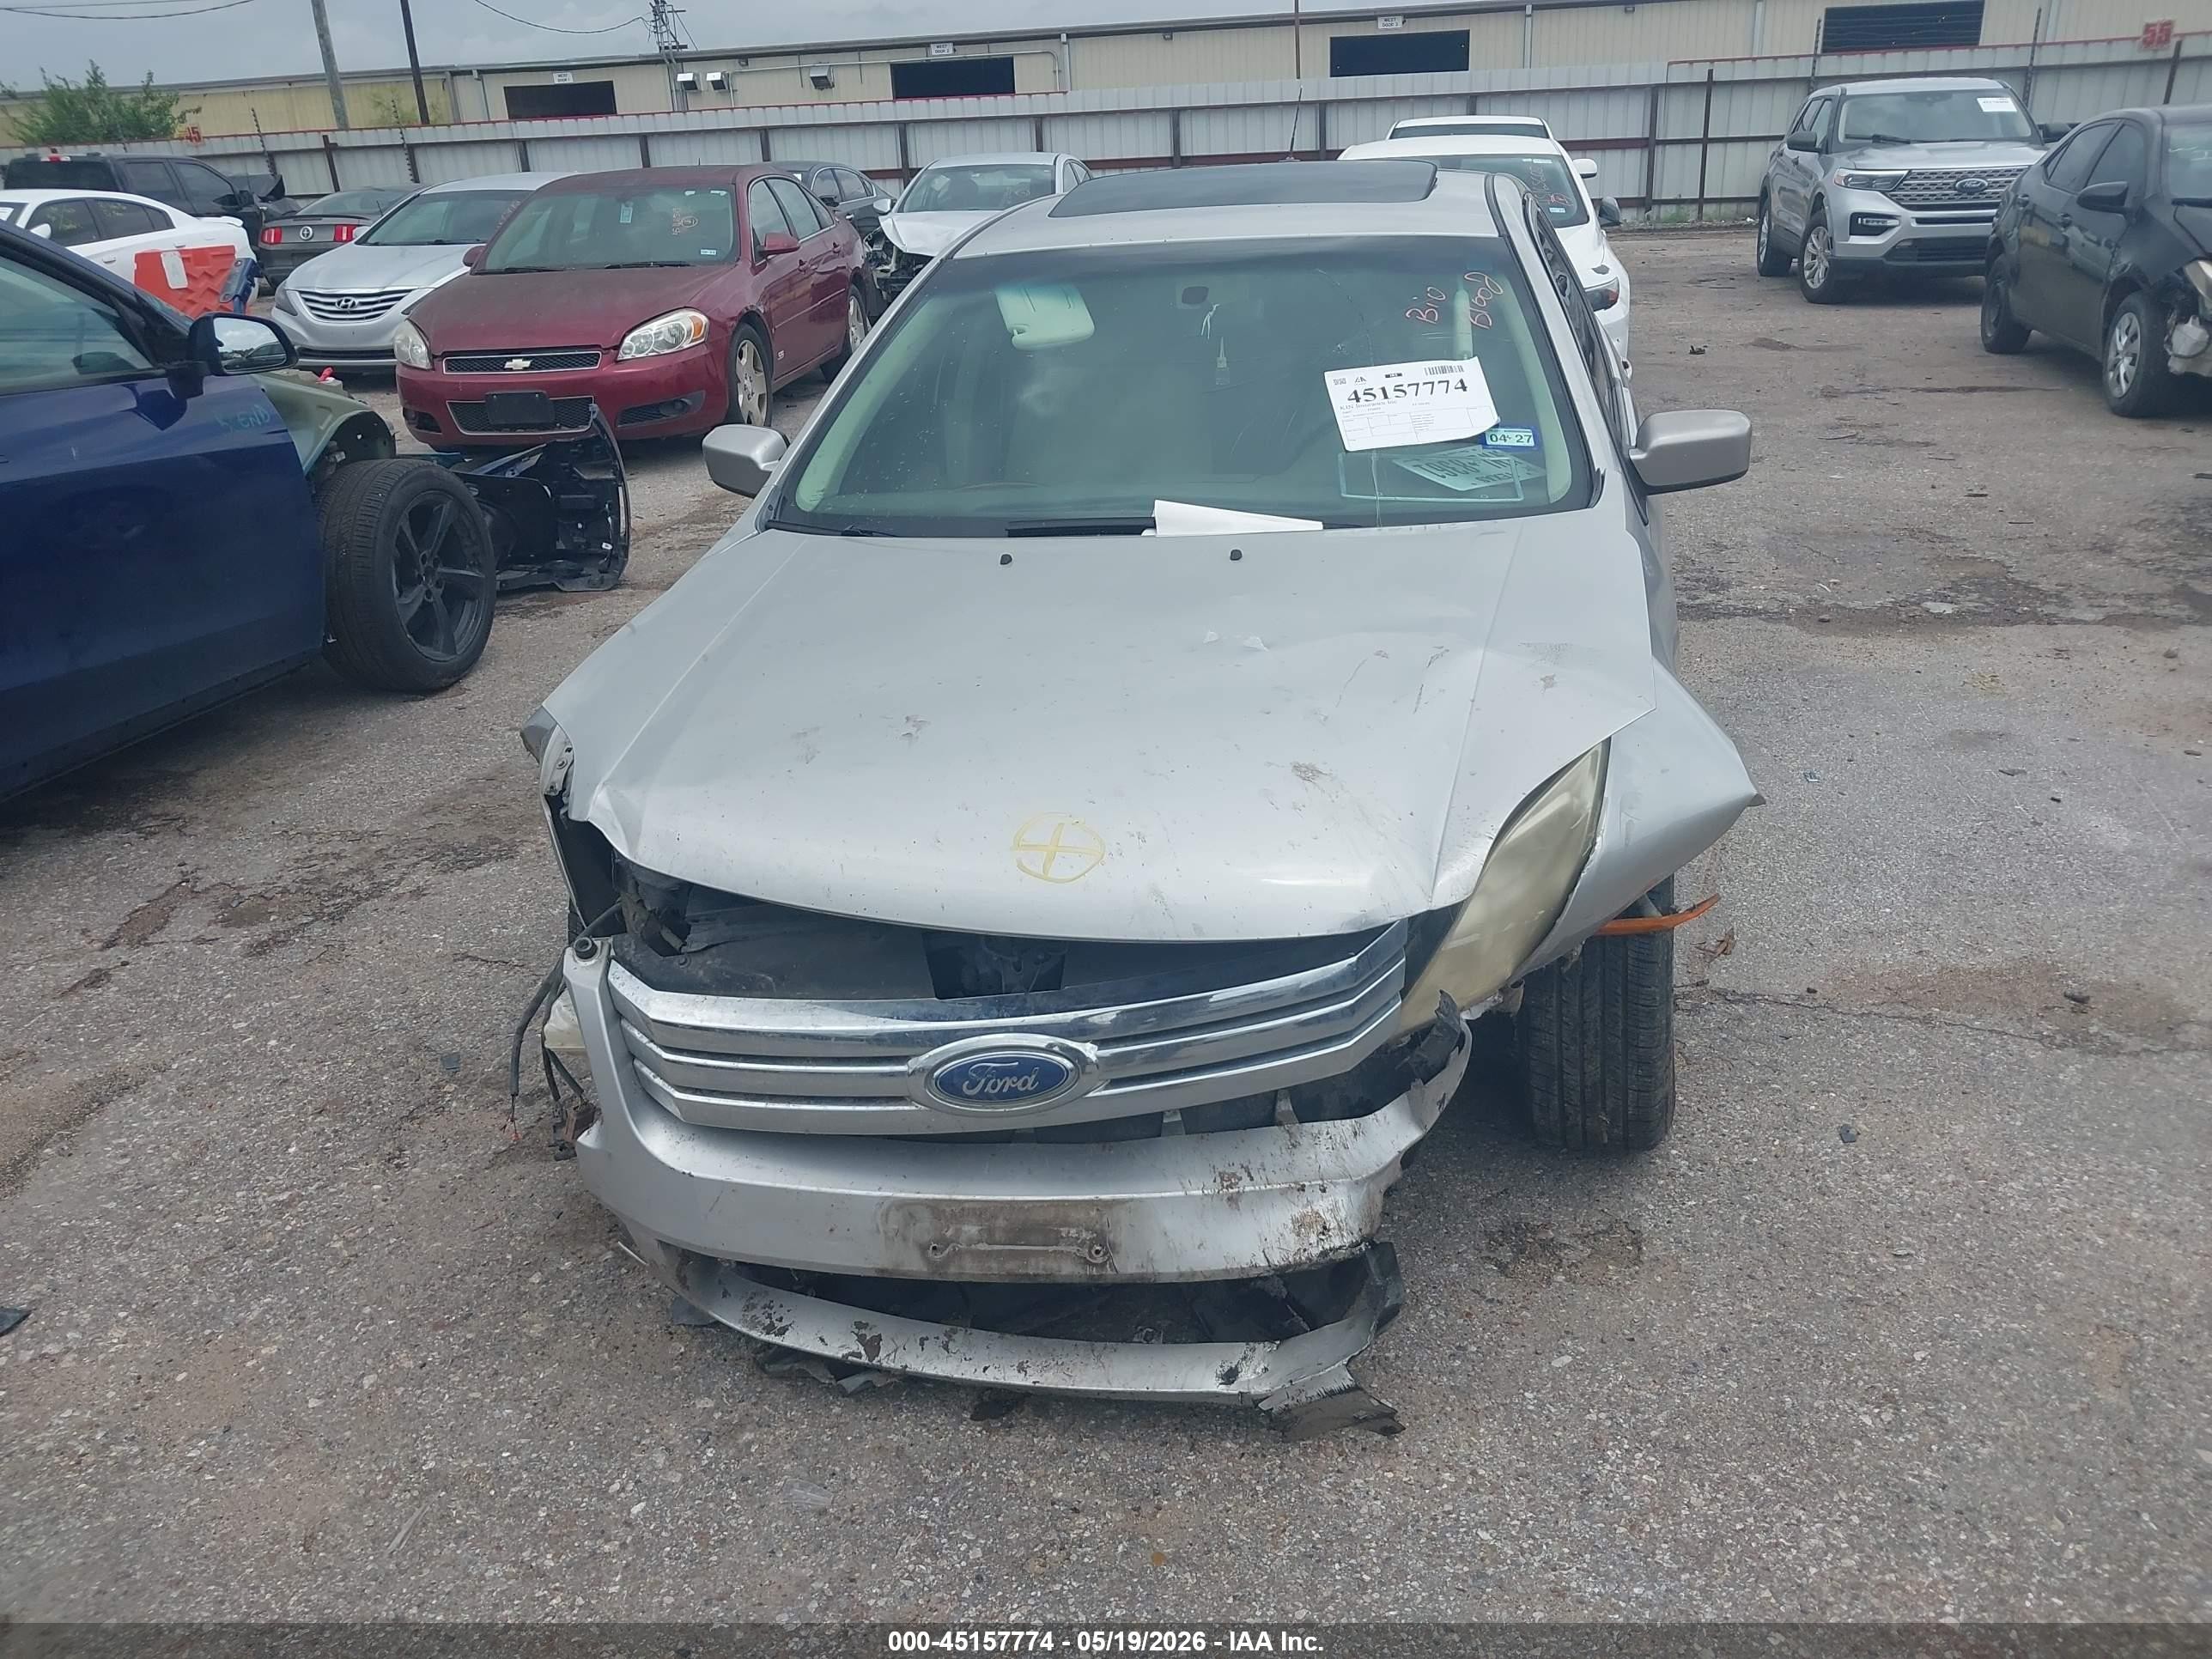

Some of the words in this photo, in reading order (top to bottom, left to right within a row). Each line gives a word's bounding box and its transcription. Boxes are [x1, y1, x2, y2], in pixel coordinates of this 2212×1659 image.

[2142, 20, 2172, 48] 55
[1406, 286, 1446, 324] Bio
[1464, 271, 1504, 330] Blood
[1347, 378, 1468, 403] 45157774
[1515, 434, 1533, 443] 27
[962, 1061, 1040, 1096] Ford
